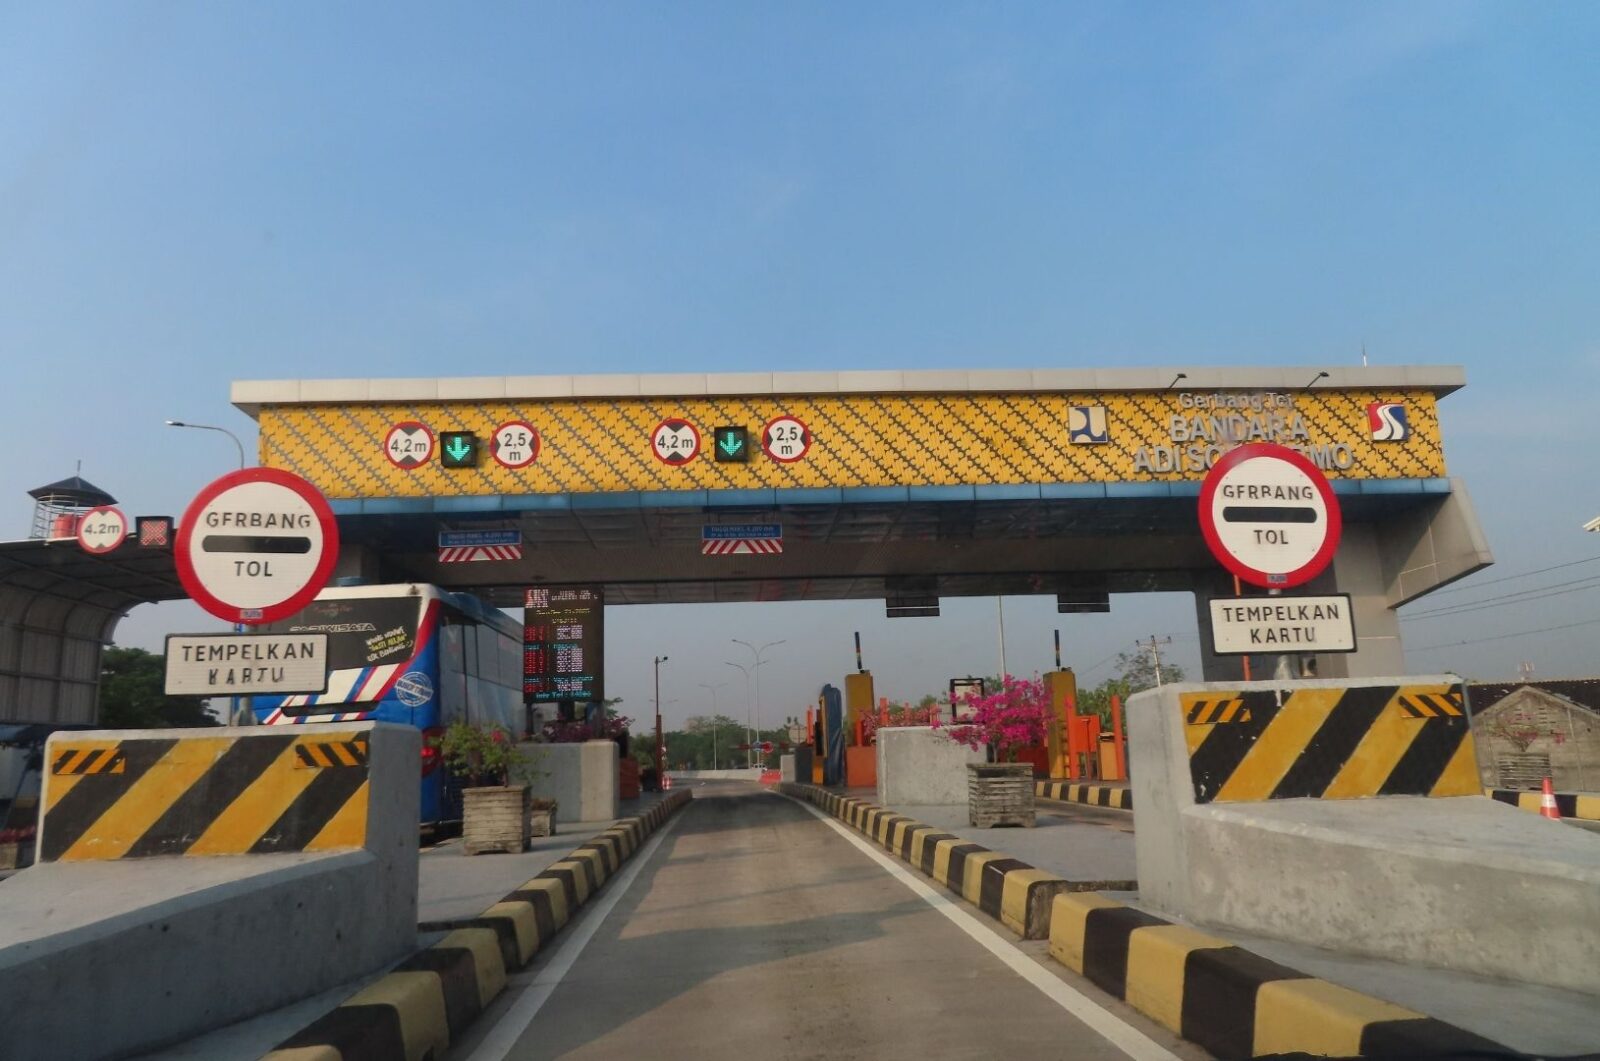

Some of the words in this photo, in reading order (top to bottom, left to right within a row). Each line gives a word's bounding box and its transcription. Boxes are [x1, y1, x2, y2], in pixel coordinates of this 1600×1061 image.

[1179, 392, 1263, 412] Gerbang
[776, 427, 798, 442] 2,5
[1170, 415, 1310, 442] BANDARA
[390, 439, 412, 453] 4,2
[414, 442, 427, 452] m
[504, 433, 526, 448] 2,5
[657, 435, 679, 450] 4,2
[681, 439, 694, 449] m
[509, 450, 521, 461] m
[781, 445, 793, 455] m
[1253, 529, 1288, 545] TOL
[234, 561, 273, 577] TOL
[1223, 604, 1339, 622] TEMPELKAN
[1250, 627, 1315, 643] KARTU
[182, 642, 314, 662] TEMPELKAN
[208, 667, 284, 685] KARTU
